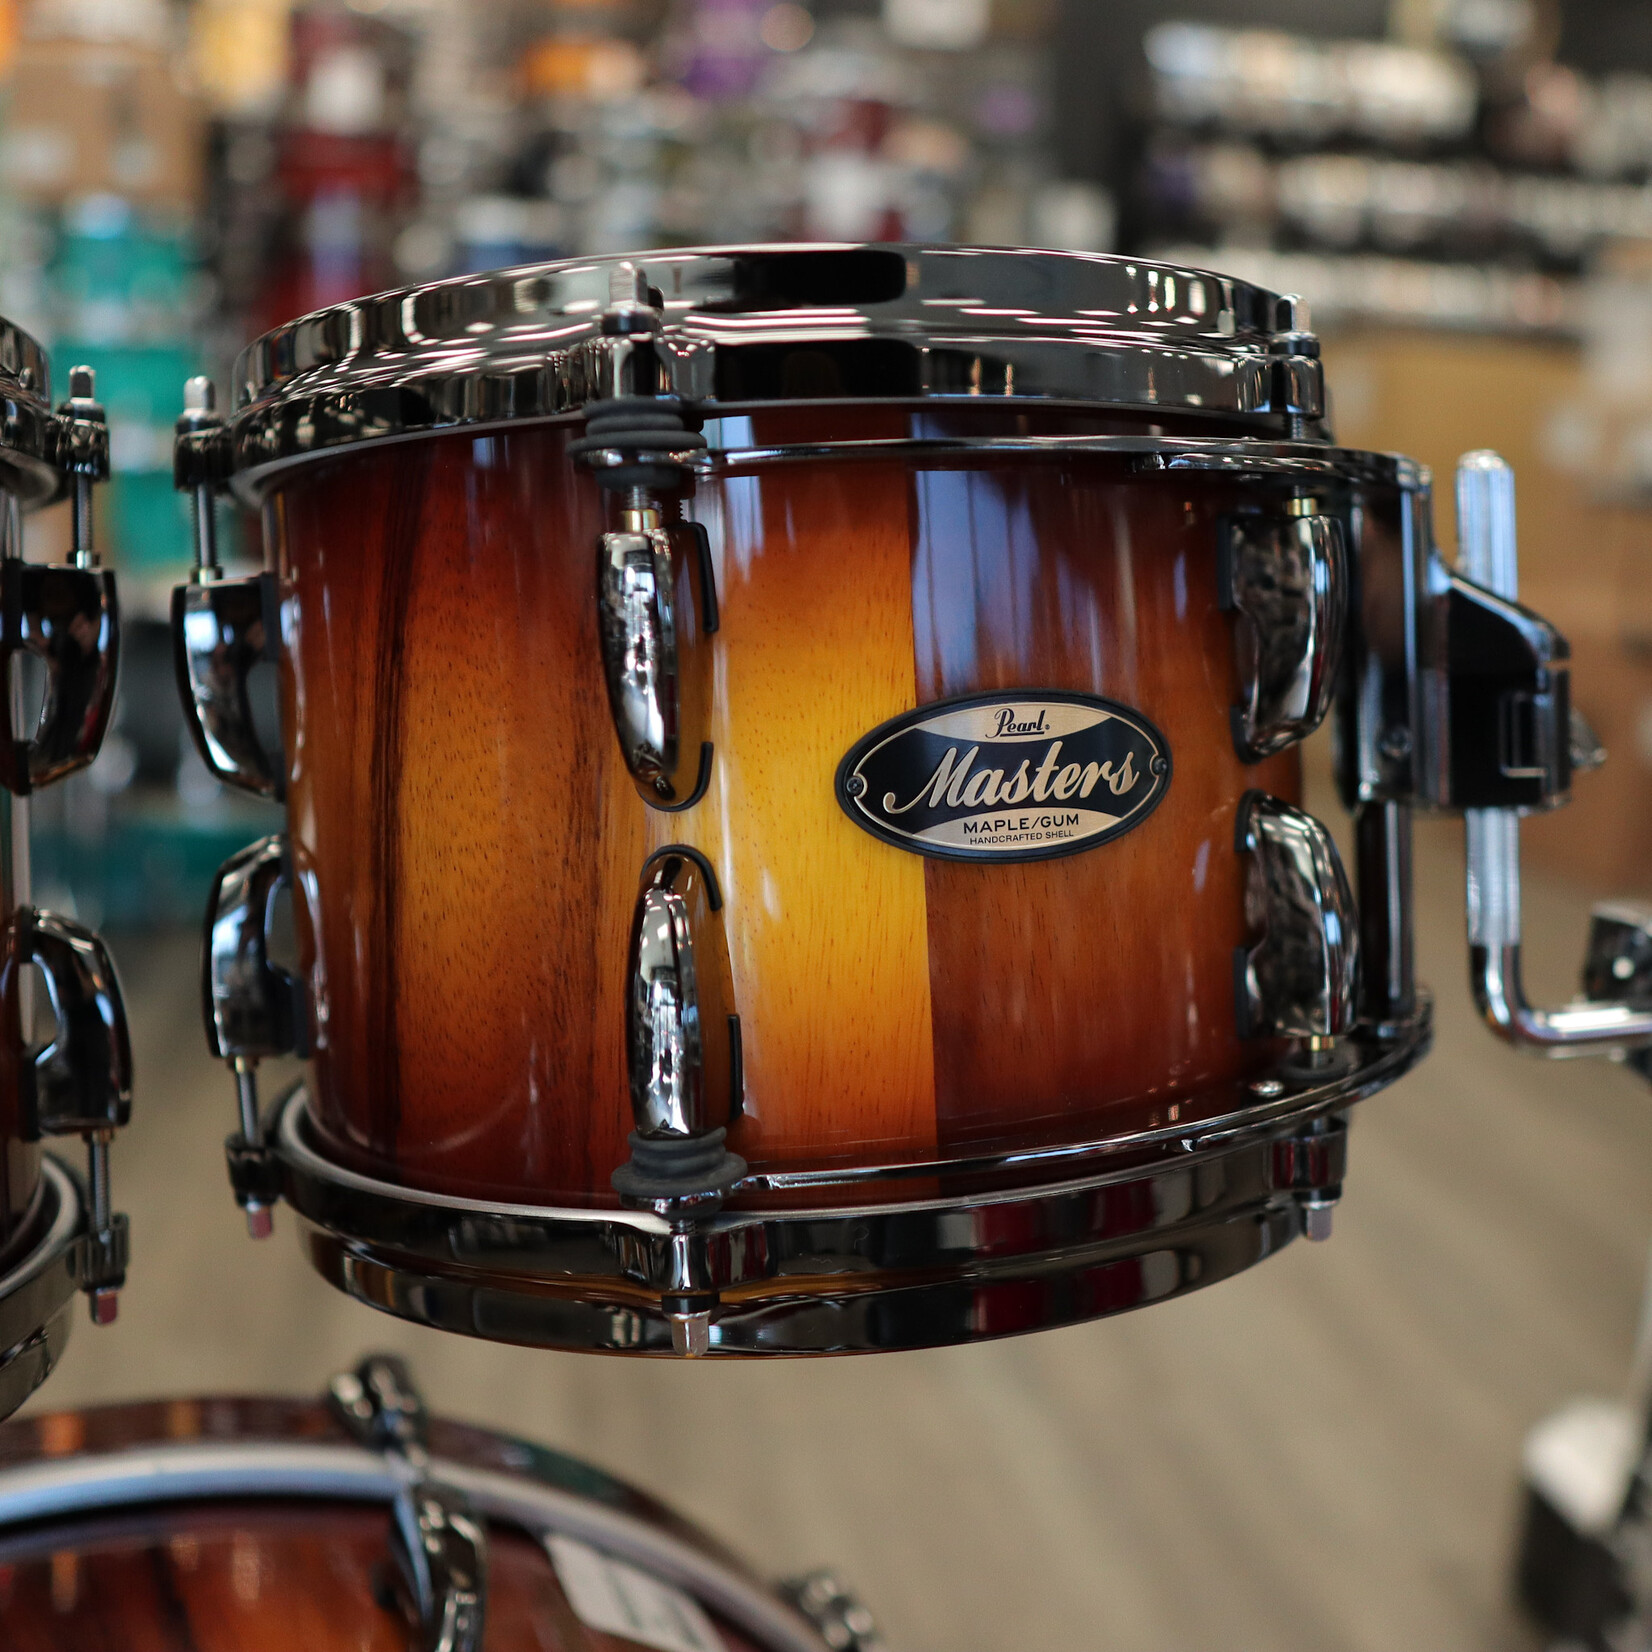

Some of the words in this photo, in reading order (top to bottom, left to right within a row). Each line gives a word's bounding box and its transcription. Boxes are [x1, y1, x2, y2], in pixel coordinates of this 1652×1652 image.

[985, 707, 1046, 739] Pearl
[883, 741, 1140, 814] Masters
[963, 813, 1080, 834] MAPLE/GUM
[969, 831, 1043, 845] HANDCRAFTED
[1045, 829, 1074, 839] SHELL
